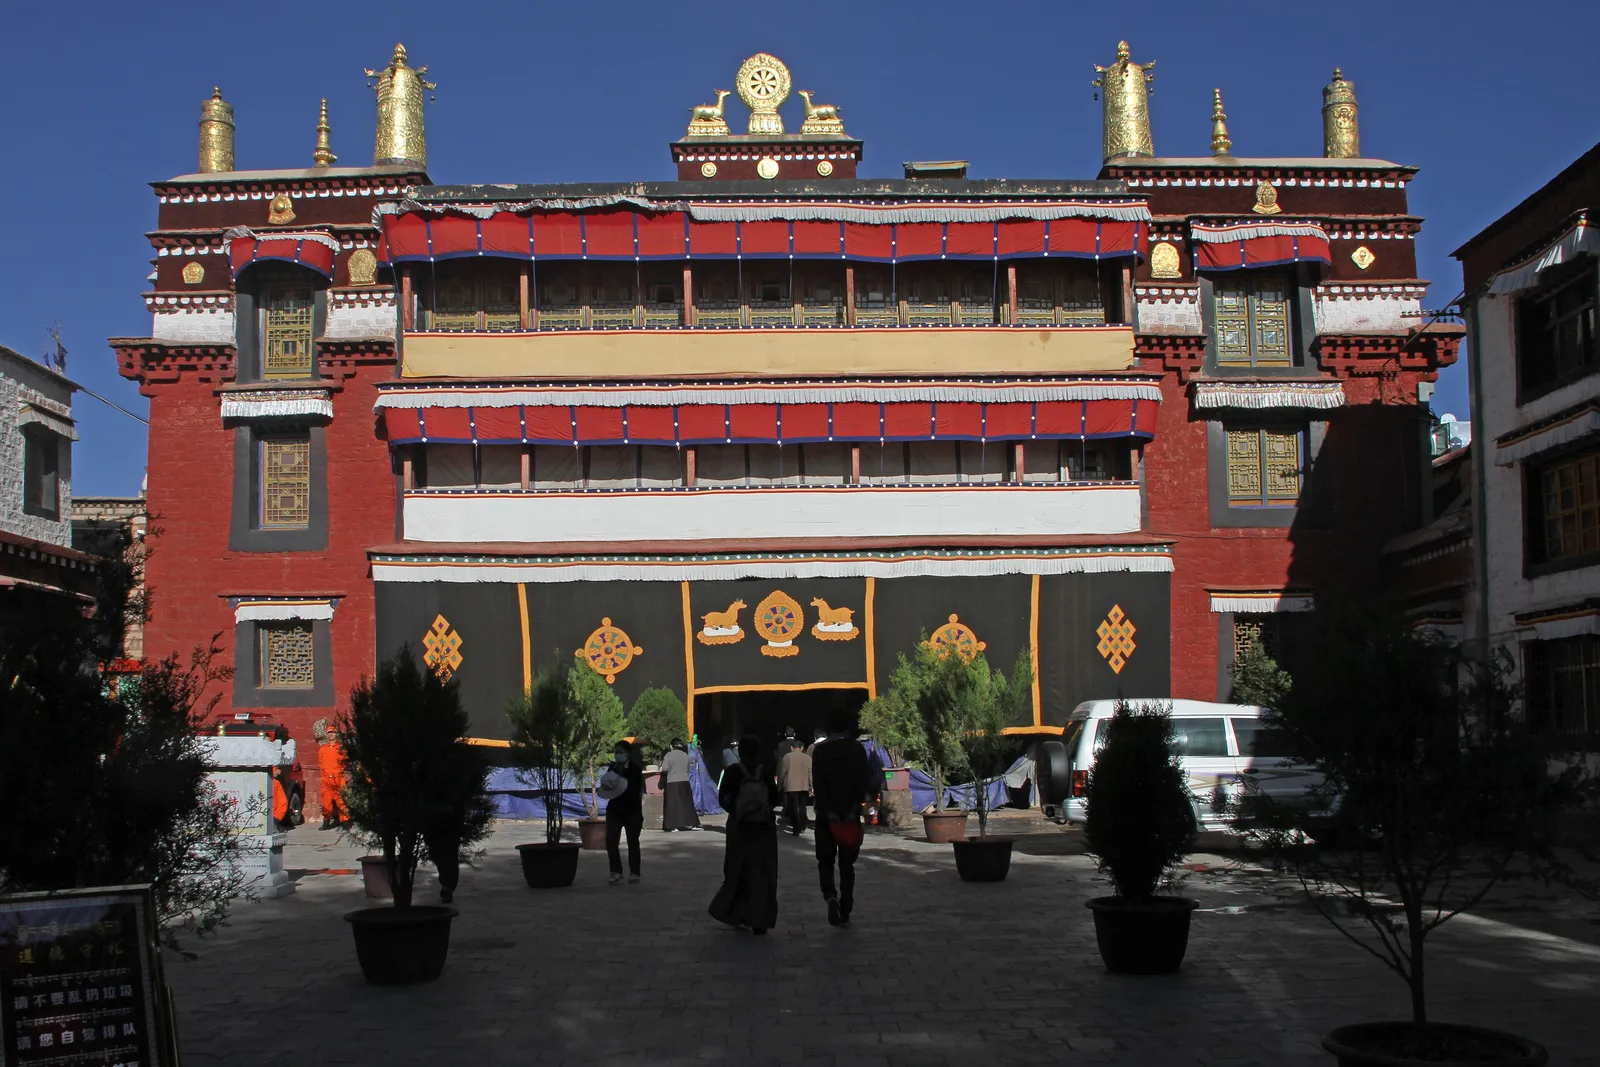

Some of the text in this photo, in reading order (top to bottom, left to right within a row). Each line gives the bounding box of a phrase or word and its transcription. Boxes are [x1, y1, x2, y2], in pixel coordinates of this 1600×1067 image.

[12, 984, 133, 1010] 请不要乱扔垃圾
[16, 1022, 137, 1051] 请您自觉排队
